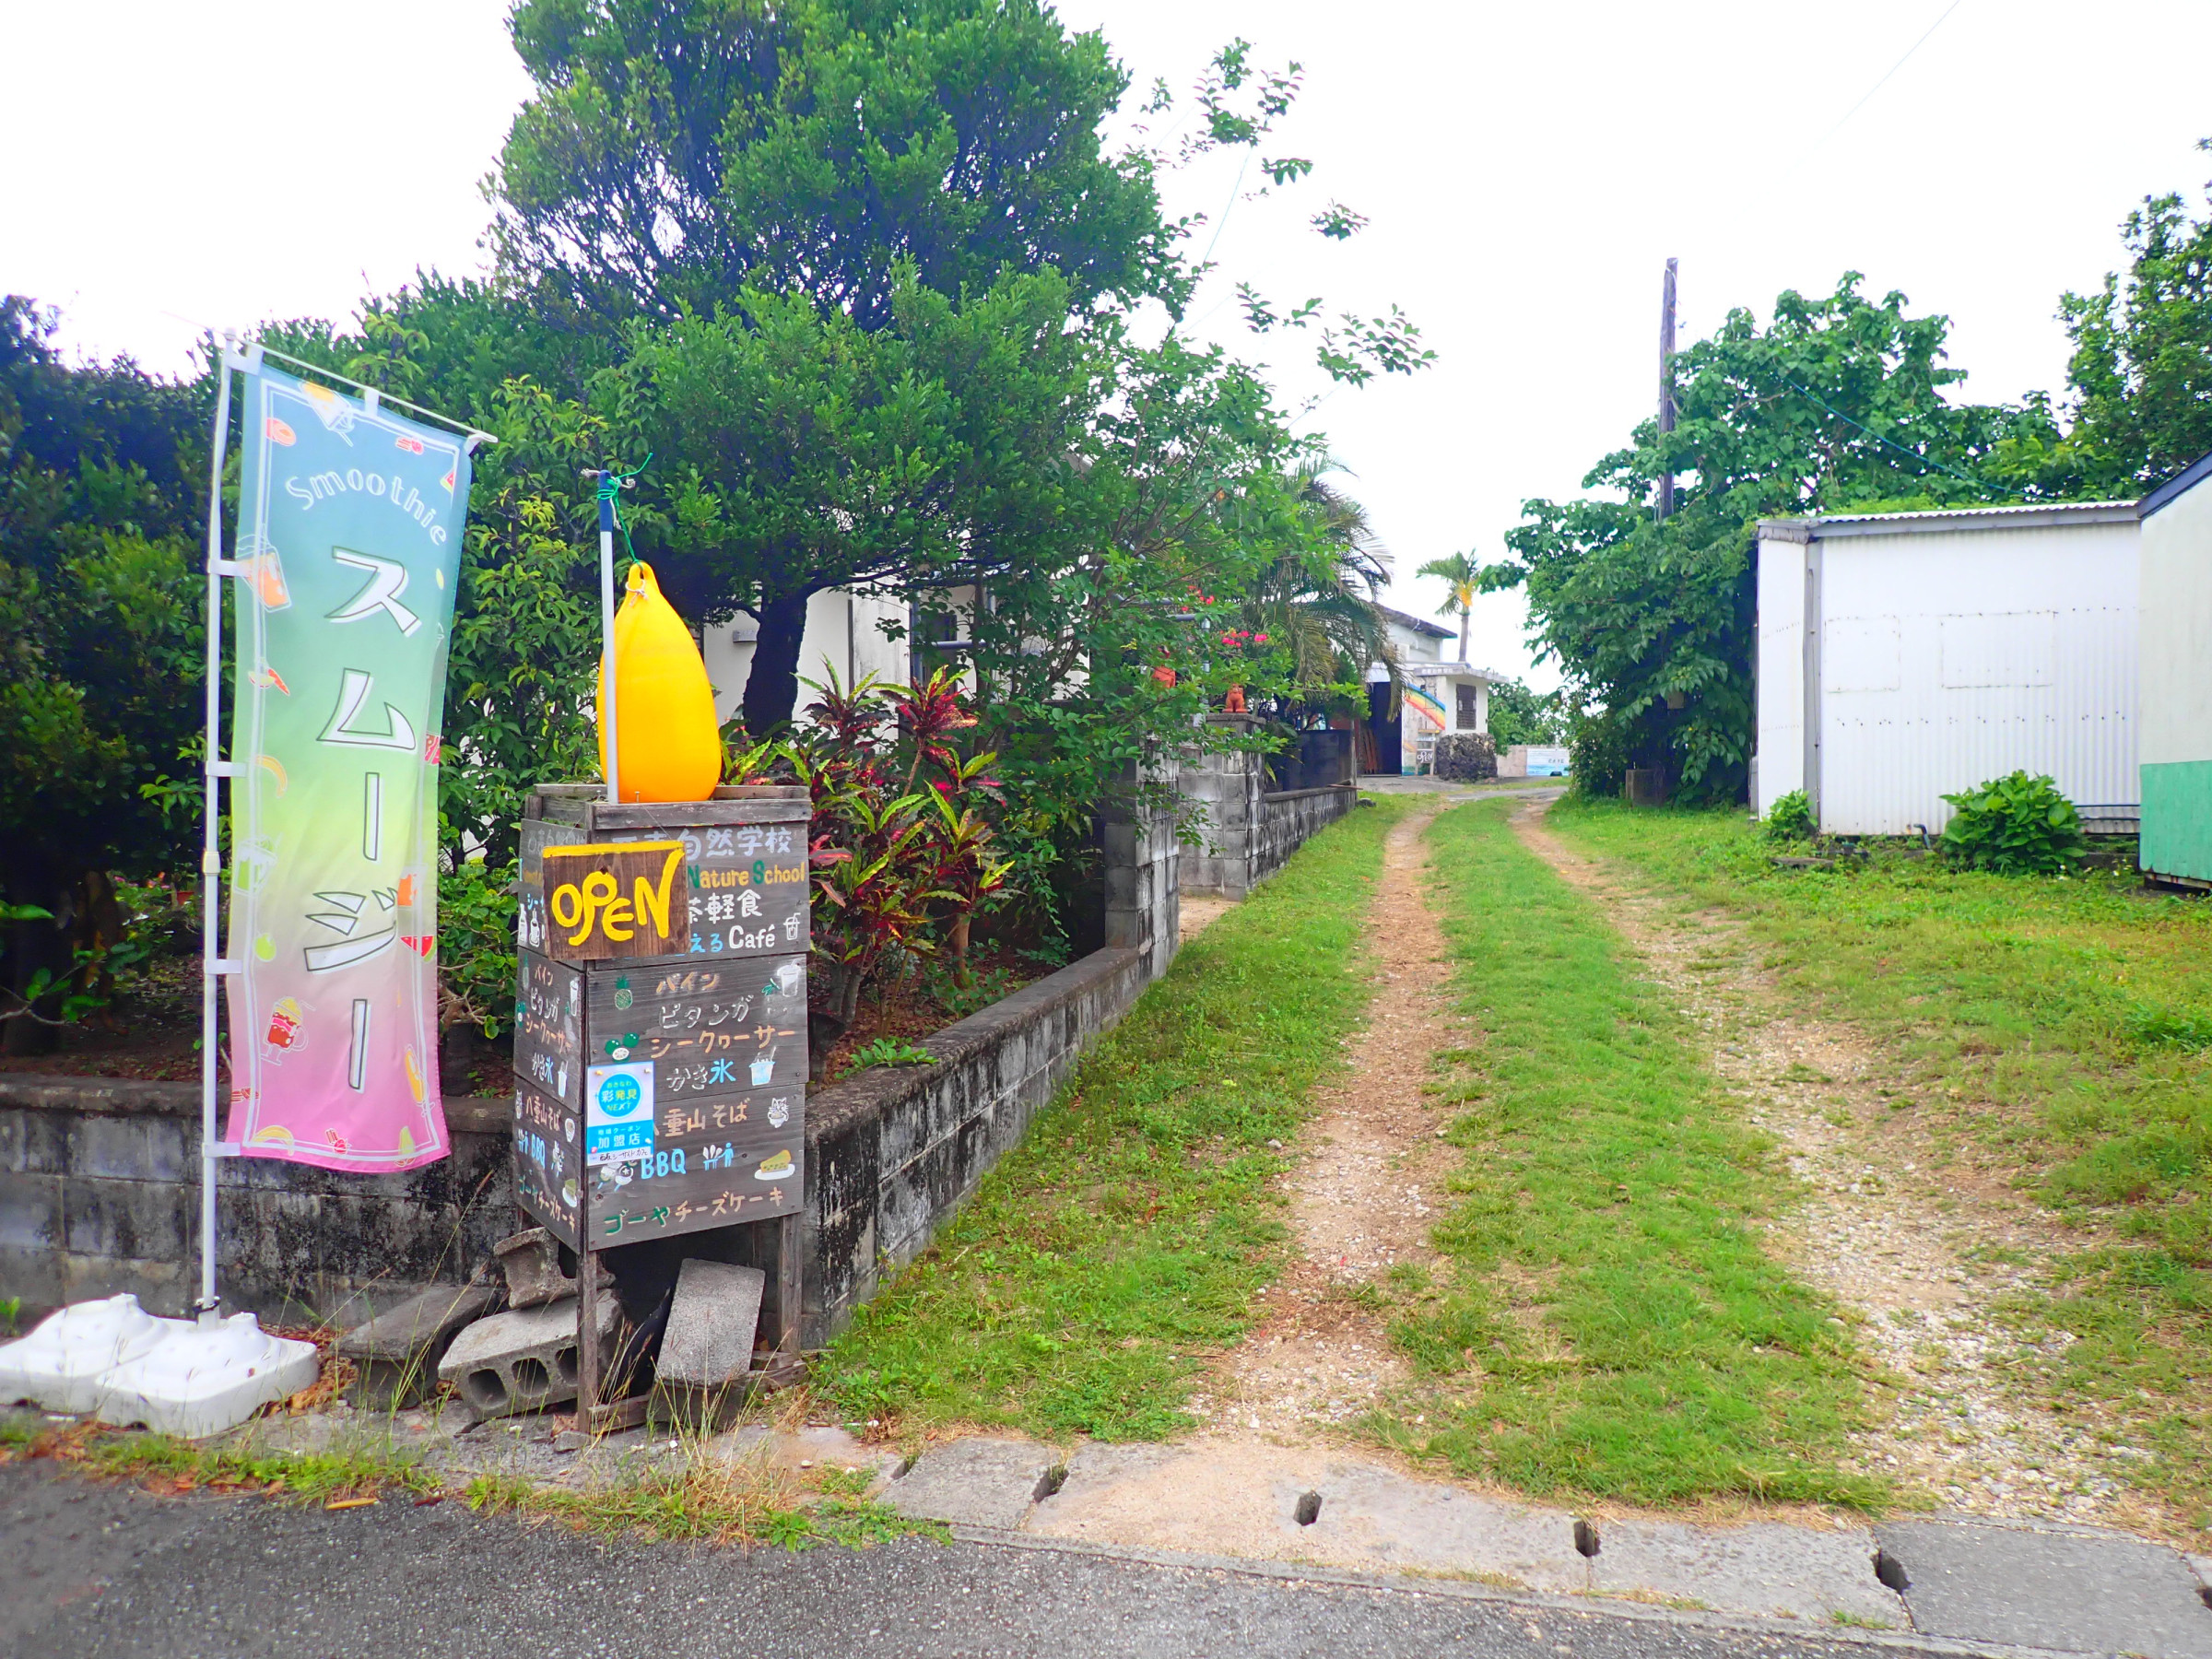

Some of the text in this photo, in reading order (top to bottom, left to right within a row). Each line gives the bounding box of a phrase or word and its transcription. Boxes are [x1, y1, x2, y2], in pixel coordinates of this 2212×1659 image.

[285, 467, 447, 547] Smoothie
[304, 546, 422, 1094] スムージー
[612, 826, 793, 861] 自然学校
[688, 859, 806, 889] Nature School
[551, 847, 686, 947] OPEN
[728, 924, 776, 949] Café
[666, 1058, 736, 1092] かき氷
[531, 1133, 546, 1171] BBQ
[597, 1133, 641, 1149] 加盟店
[641, 1147, 687, 1180] BBQ
[604, 1186, 784, 1237] ゴーヤチーズケーキ
